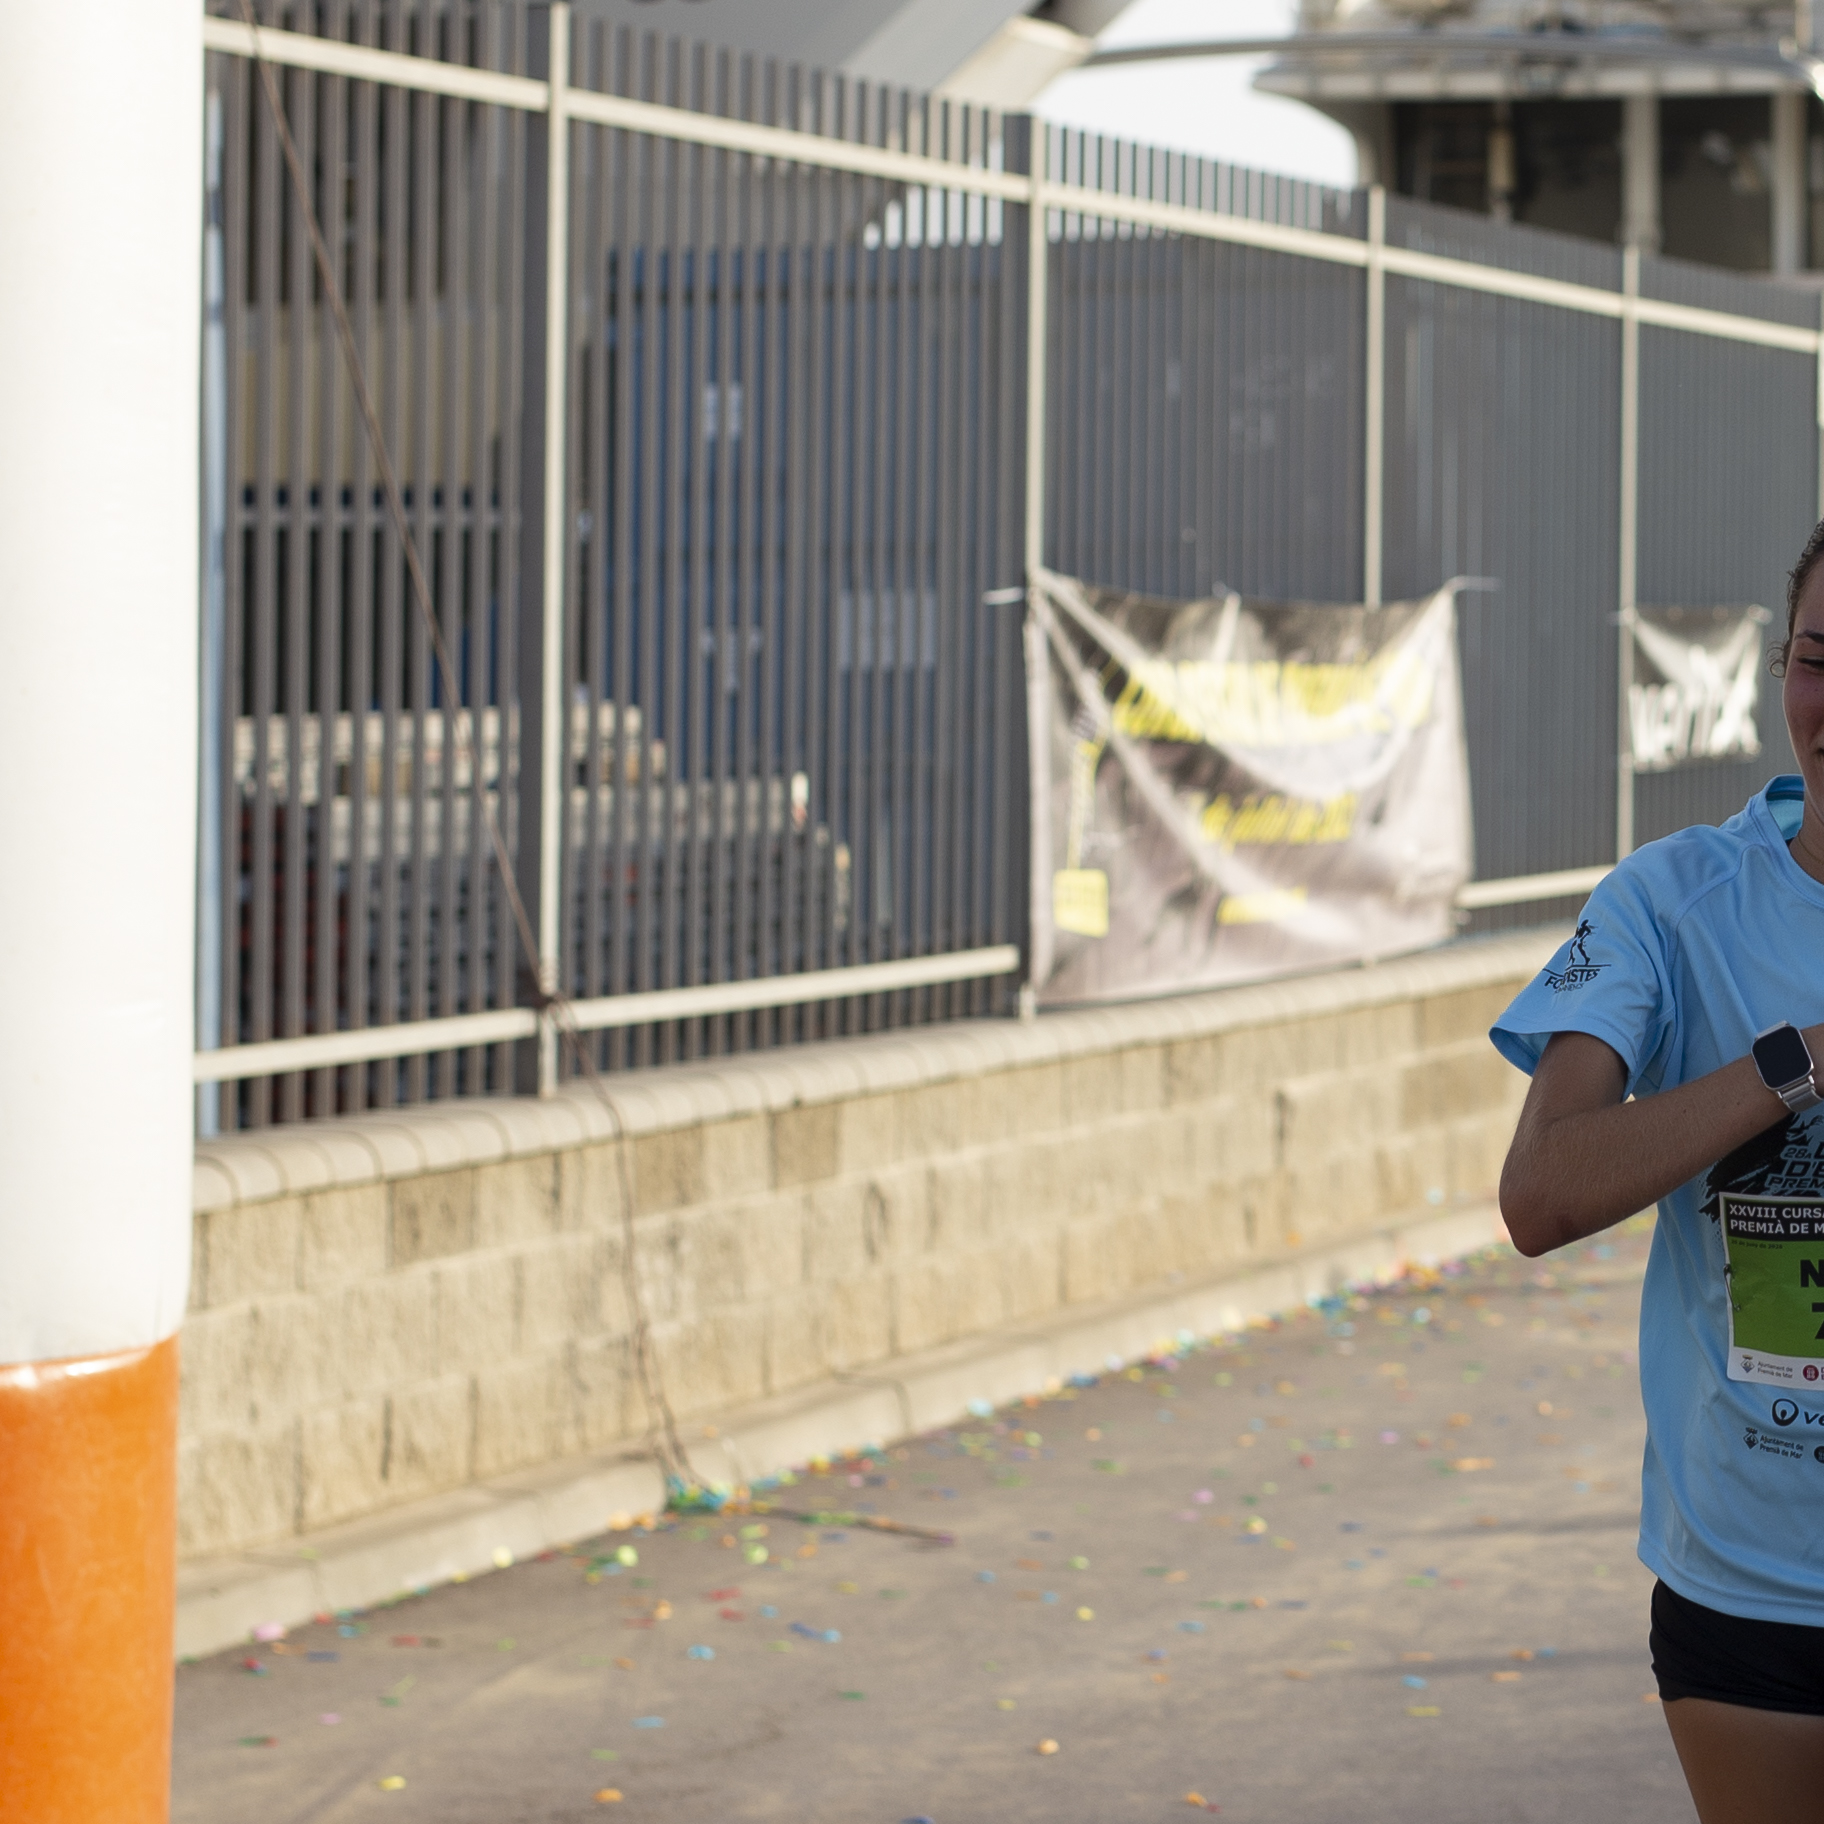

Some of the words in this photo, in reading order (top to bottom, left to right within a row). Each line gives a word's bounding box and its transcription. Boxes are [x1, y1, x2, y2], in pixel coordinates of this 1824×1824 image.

[1729, 1203, 1777, 1218] XXVIII
[1730, 1219, 1785, 1234] PREMIÀ
[1790, 1223, 1809, 1234] DE
